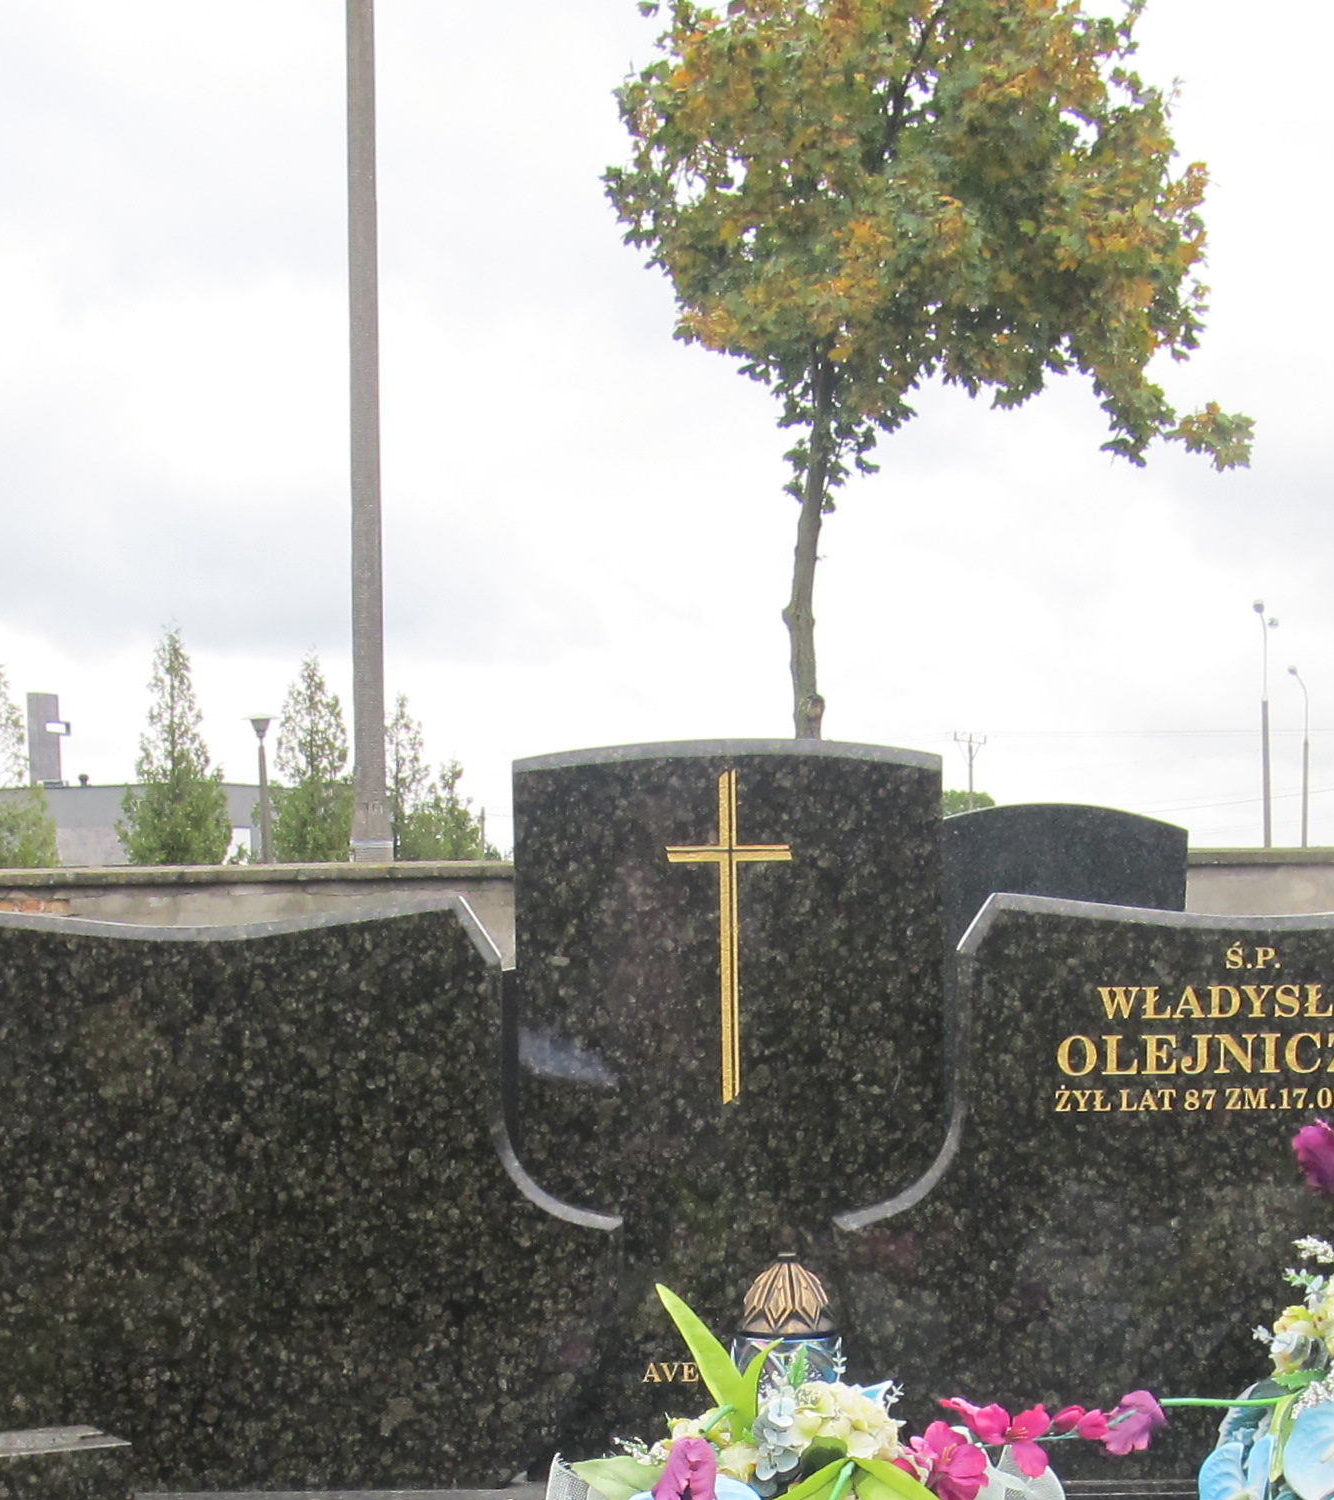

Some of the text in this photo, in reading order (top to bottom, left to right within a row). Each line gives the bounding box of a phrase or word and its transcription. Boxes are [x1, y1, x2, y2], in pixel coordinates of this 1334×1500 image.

[1225, 940, 1283, 970] Ś.P.
[1054, 1084, 1112, 1113] ŻYŁ
[1119, 1088, 1177, 1112] LAT
[1183, 1088, 1217, 1111] 87
[641, 1361, 700, 1384] AVE
